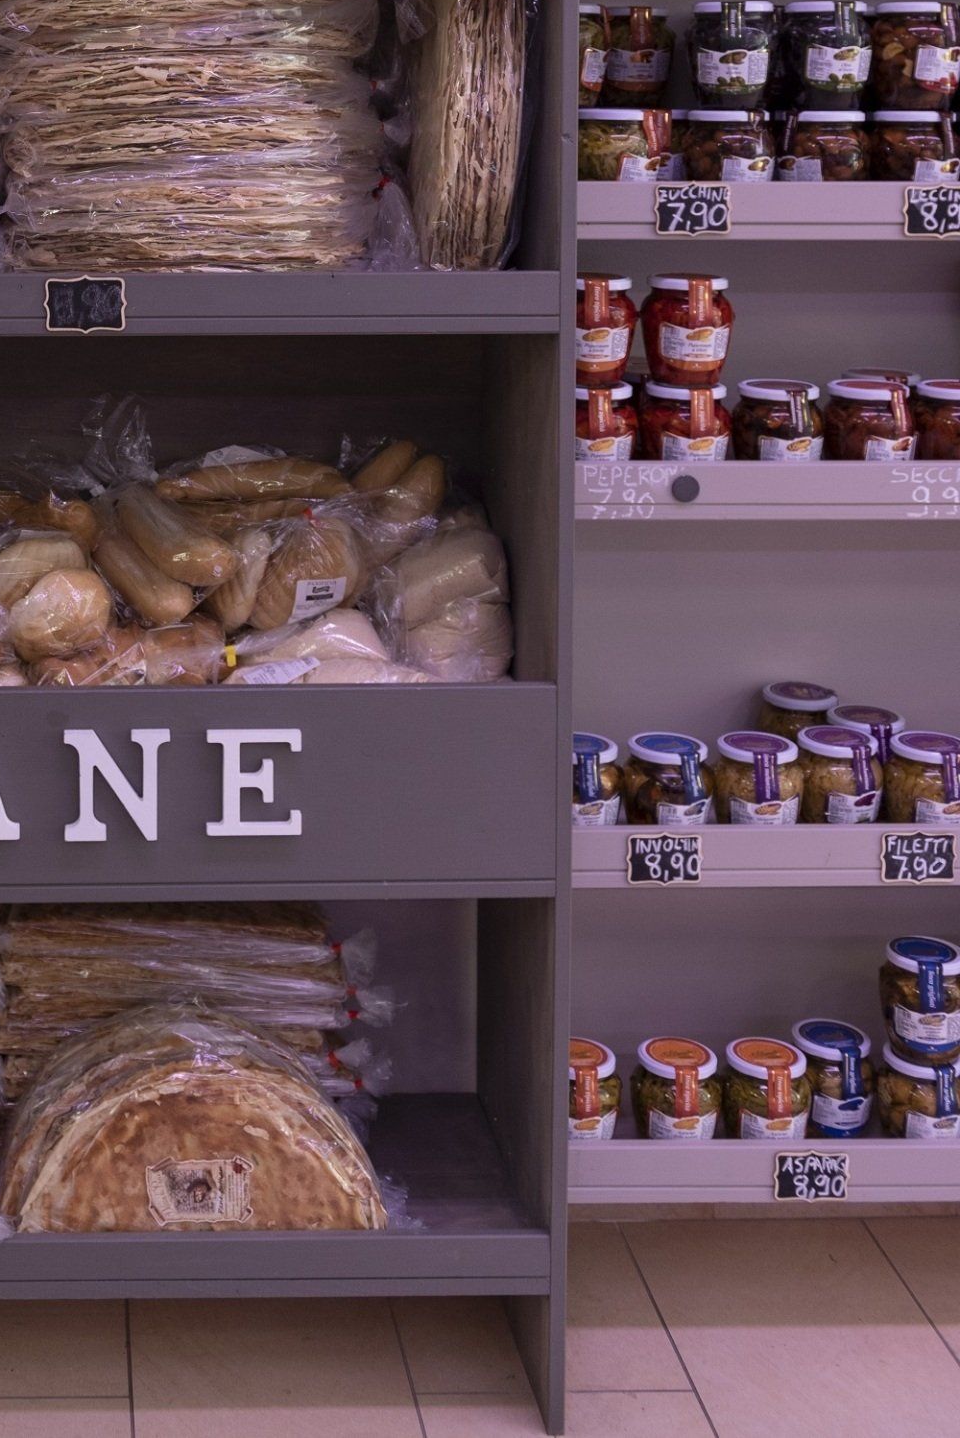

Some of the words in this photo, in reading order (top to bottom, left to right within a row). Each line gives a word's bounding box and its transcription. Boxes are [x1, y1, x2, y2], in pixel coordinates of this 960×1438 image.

[666, 201, 728, 232] 7,90
[890, 466, 960, 484] SECC
[887, 835, 948, 856] FILETTI
[644, 852, 700, 882] 8,90
[892, 854, 947, 880] 7,90
[792, 1174, 846, 1200] 8,90
